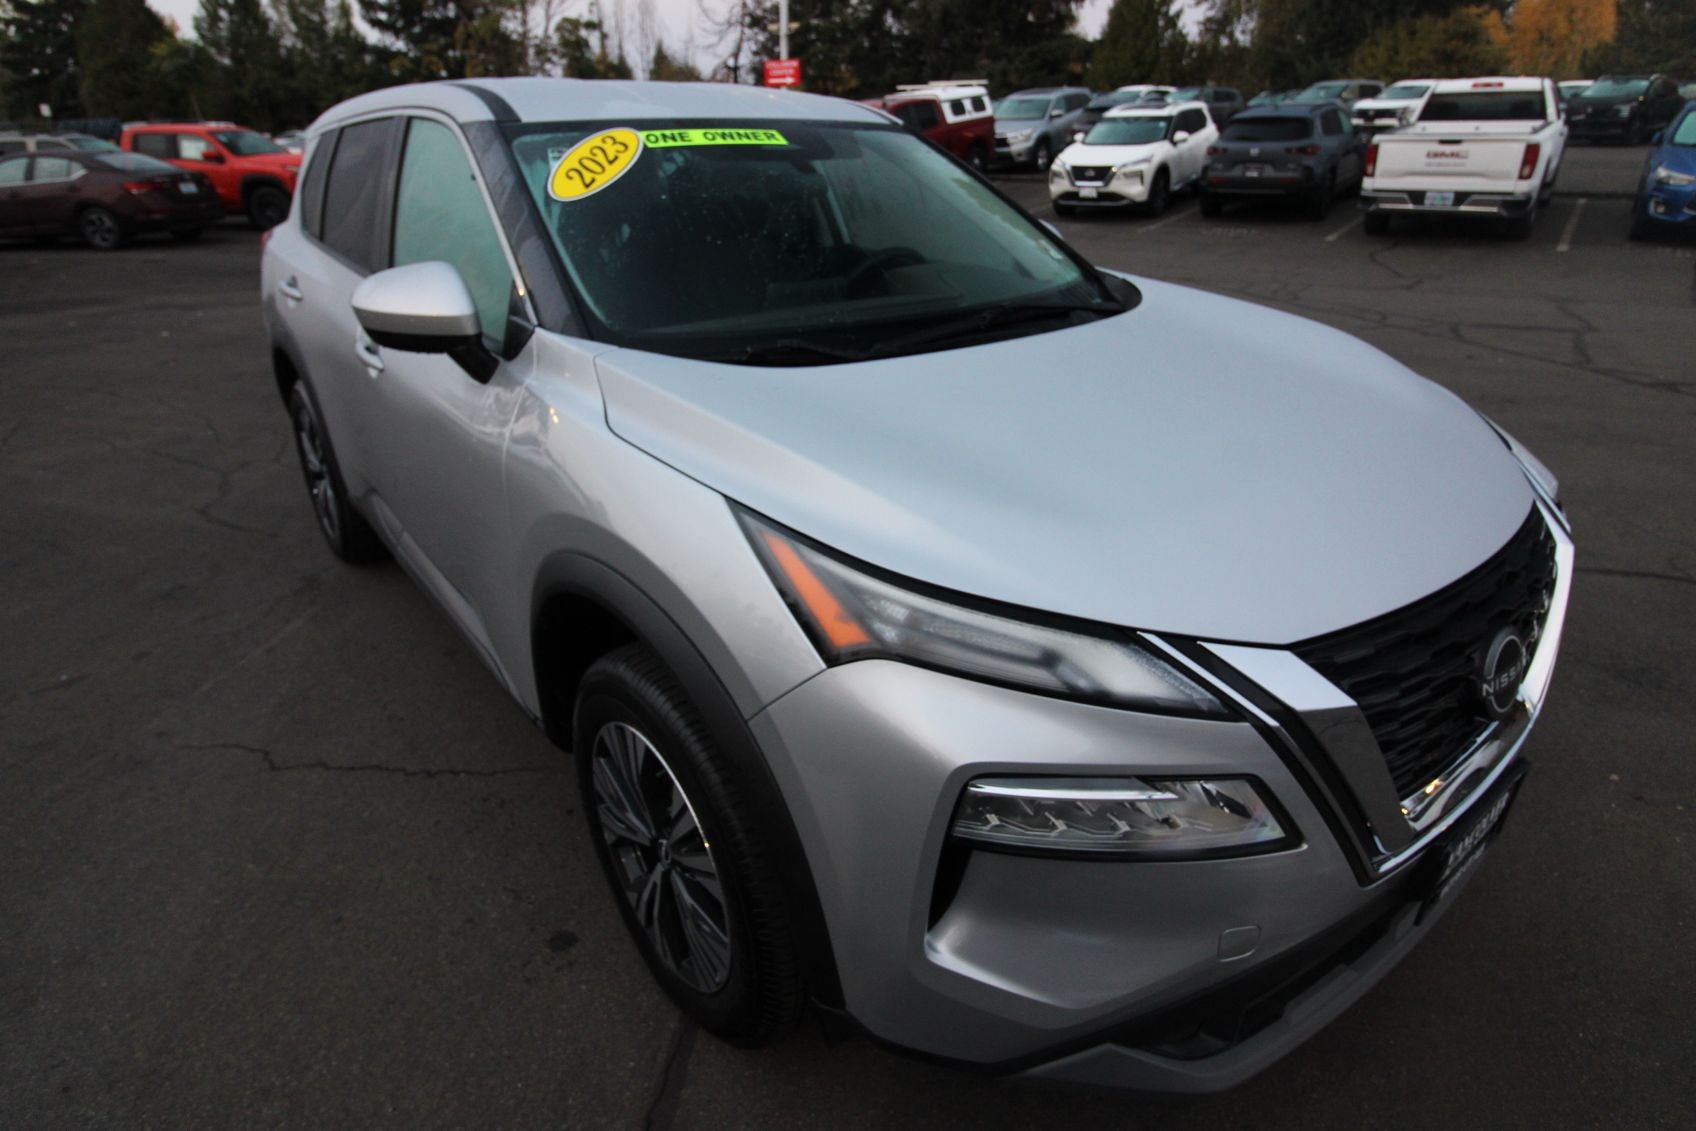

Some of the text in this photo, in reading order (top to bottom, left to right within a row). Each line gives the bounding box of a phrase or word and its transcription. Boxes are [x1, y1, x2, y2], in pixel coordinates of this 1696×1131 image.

[645, 131, 779, 144] ONE OWNER
[566, 135, 628, 189] 2023
[1425, 150, 1469, 160] GMC
[1482, 661, 1523, 697] NISSA
